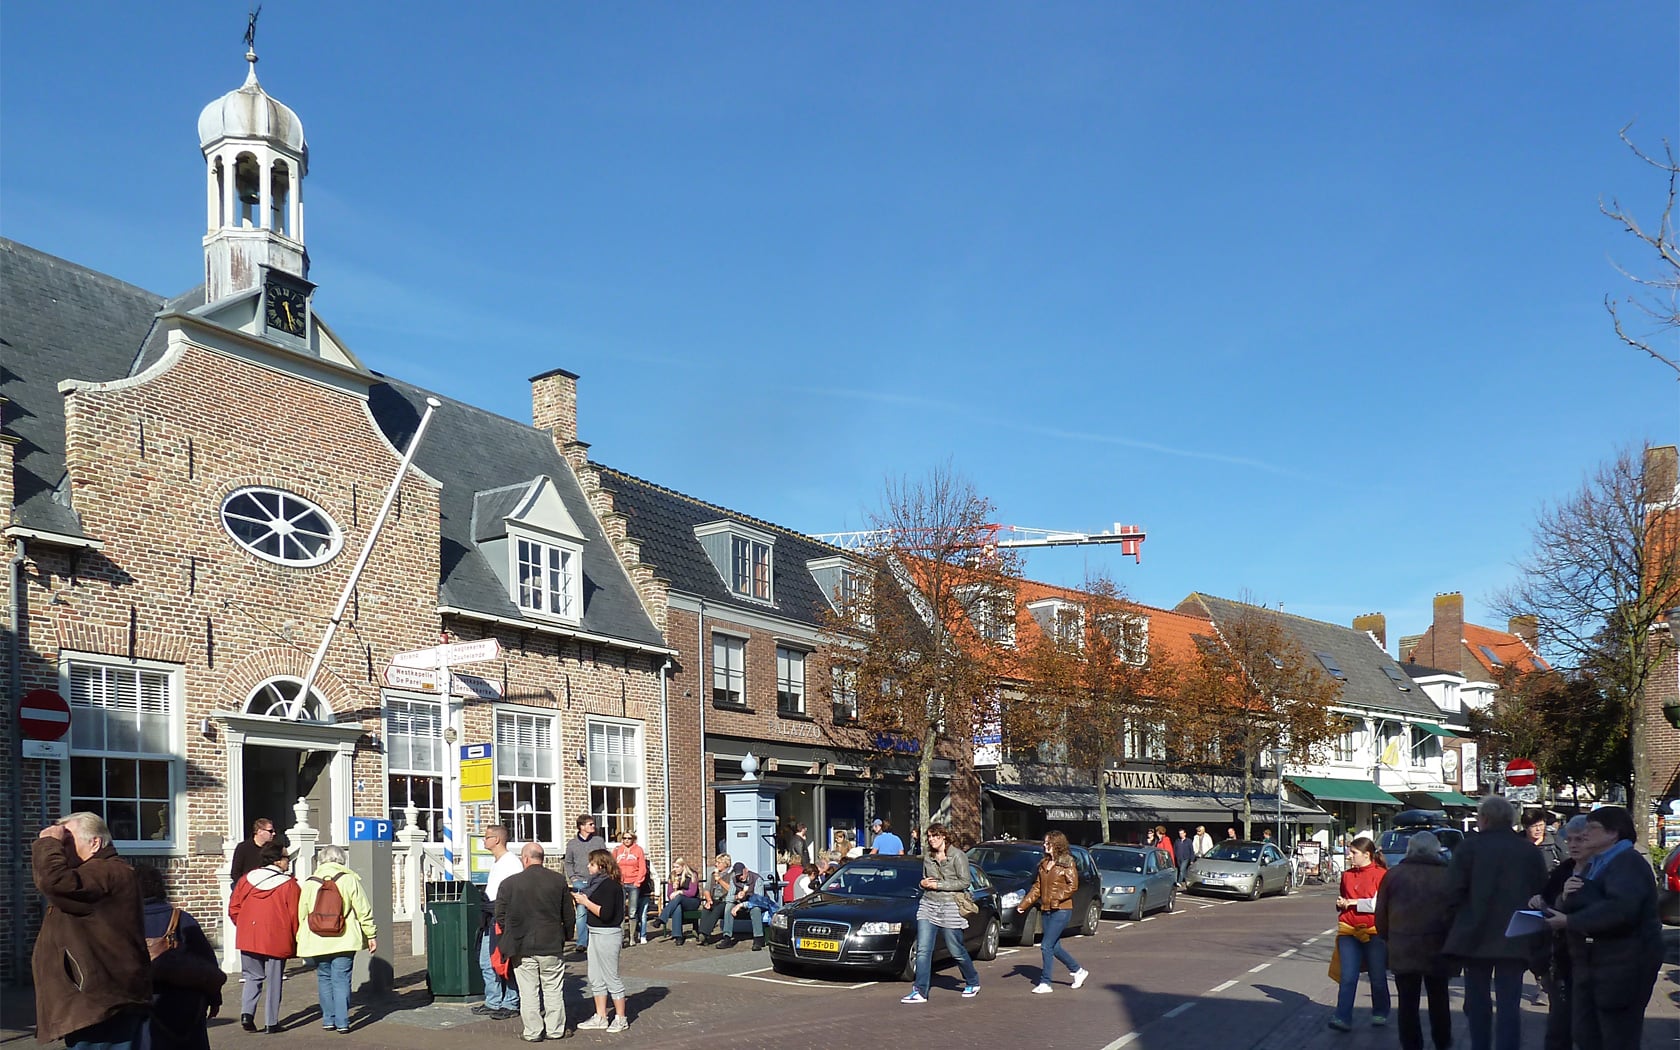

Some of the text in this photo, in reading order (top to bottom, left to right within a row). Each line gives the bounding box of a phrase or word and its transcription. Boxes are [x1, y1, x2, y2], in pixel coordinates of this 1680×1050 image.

[396, 667, 433, 679] Westkapelle
[405, 678, 422, 686] Parel
[768, 720, 821, 739] PALAZZO
[354, 820, 365, 839] P
[377, 822, 388, 839] P
[803, 940, 835, 950] 19-ST-DB
